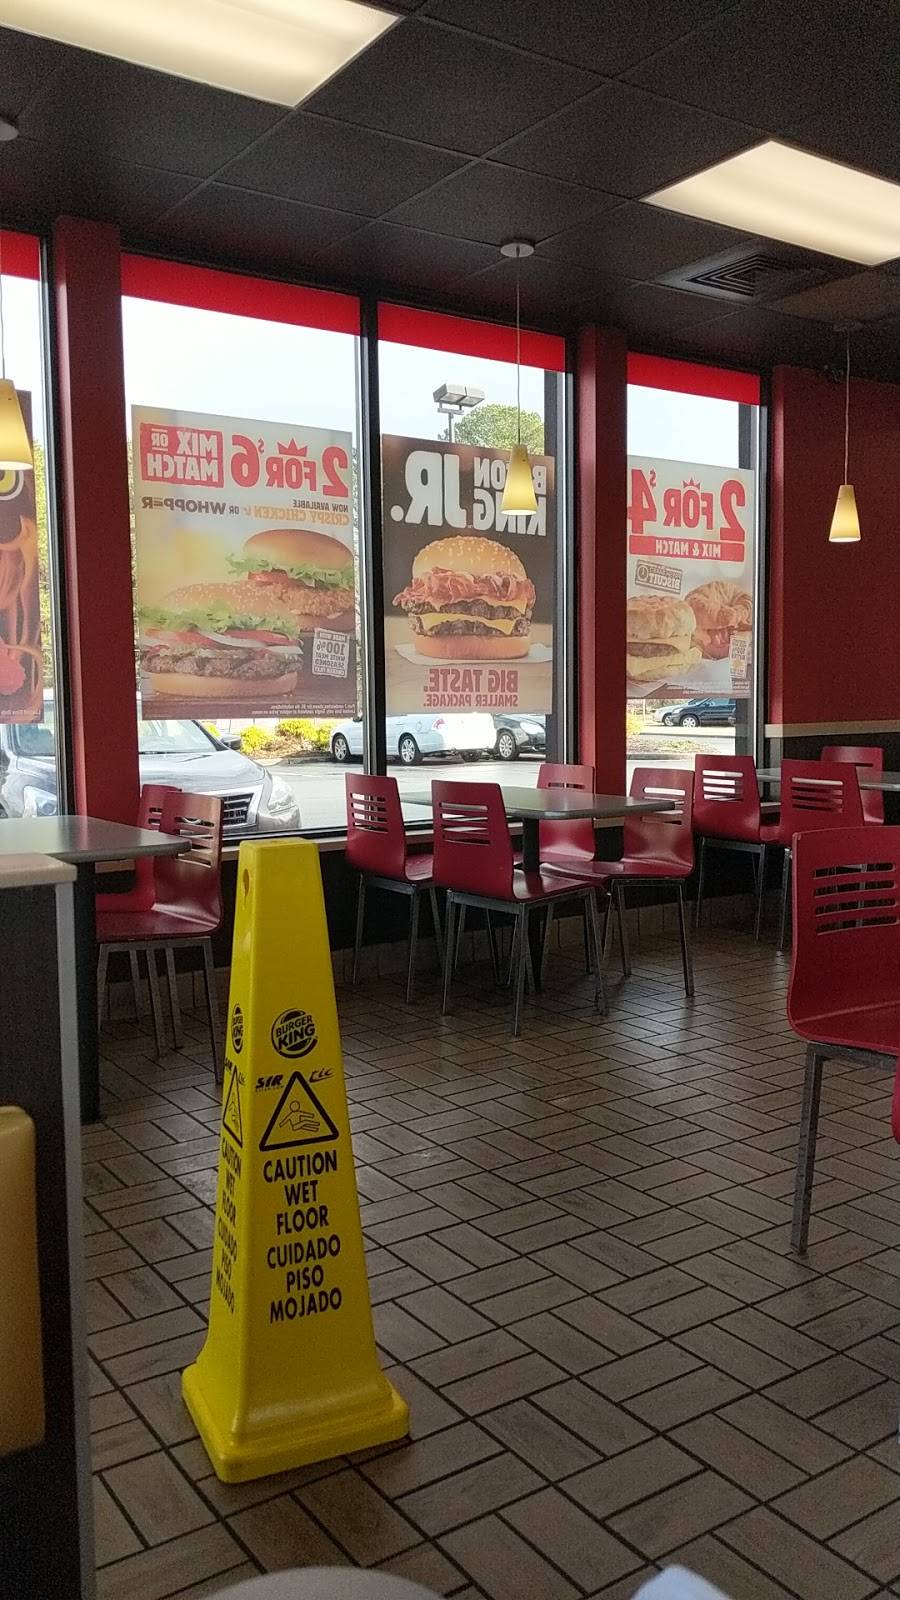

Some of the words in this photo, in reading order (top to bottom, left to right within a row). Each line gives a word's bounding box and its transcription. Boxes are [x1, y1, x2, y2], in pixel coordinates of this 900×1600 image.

[276, 1015, 313, 1038] BURGER
[277, 1024, 316, 1050] KING
[263, 1150, 338, 1183] CAUTION
[284, 1180, 319, 1206] WET
[276, 1205, 329, 1235] FLOOR
[267, 1234, 341, 1269] CUIDADO
[286, 1264, 324, 1293] PISO
[269, 1287, 342, 1324] MOJADO
